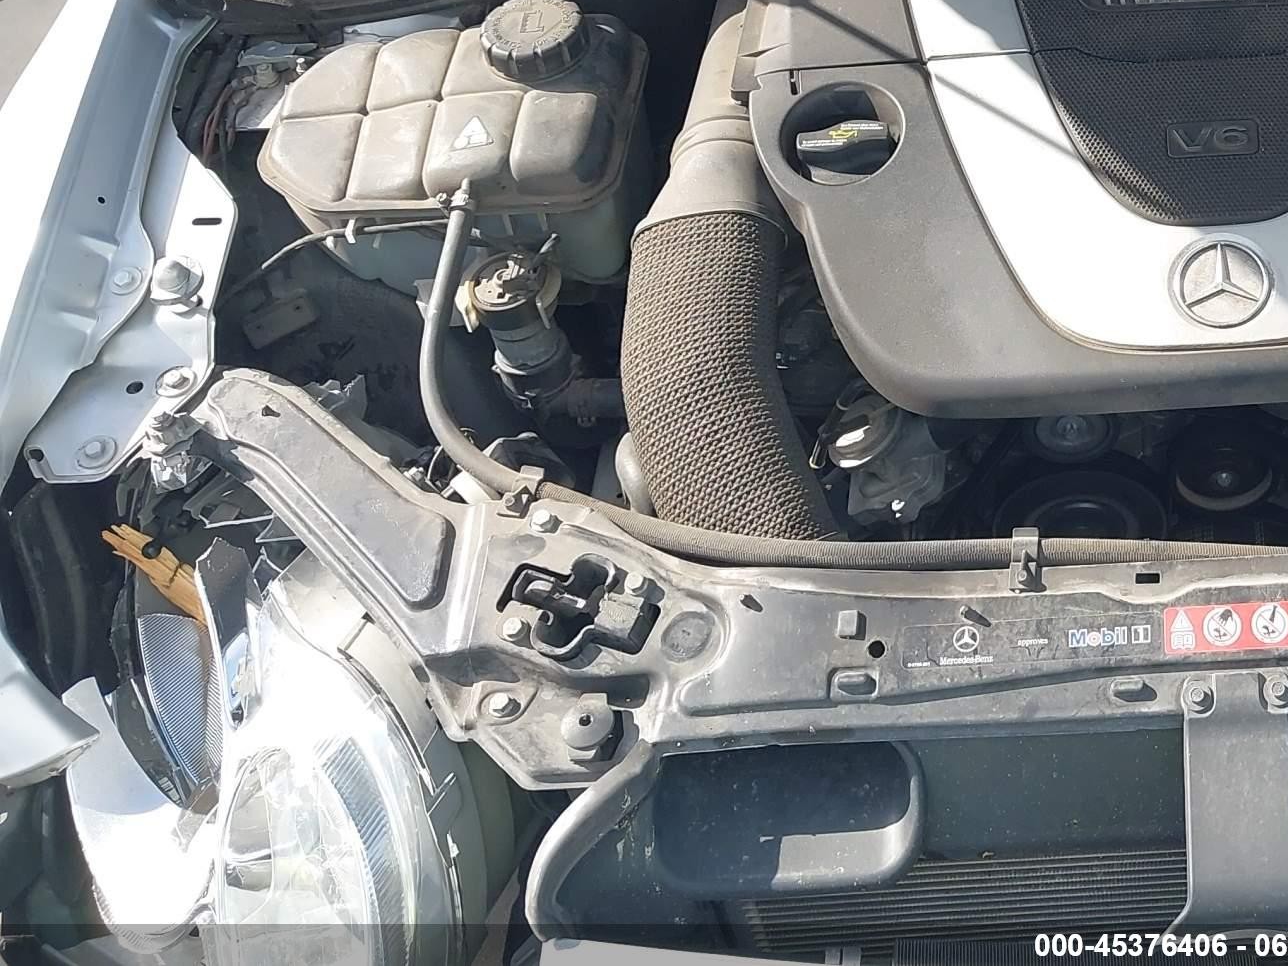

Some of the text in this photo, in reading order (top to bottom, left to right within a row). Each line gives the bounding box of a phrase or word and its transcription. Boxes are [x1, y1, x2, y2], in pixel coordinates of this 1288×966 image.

[1172, 125, 1249, 153] V6
[1017, 638, 1049, 647] approves
[1068, 626, 1128, 648] Mobil
[939, 654, 994, 666] Mercedes-Benz
